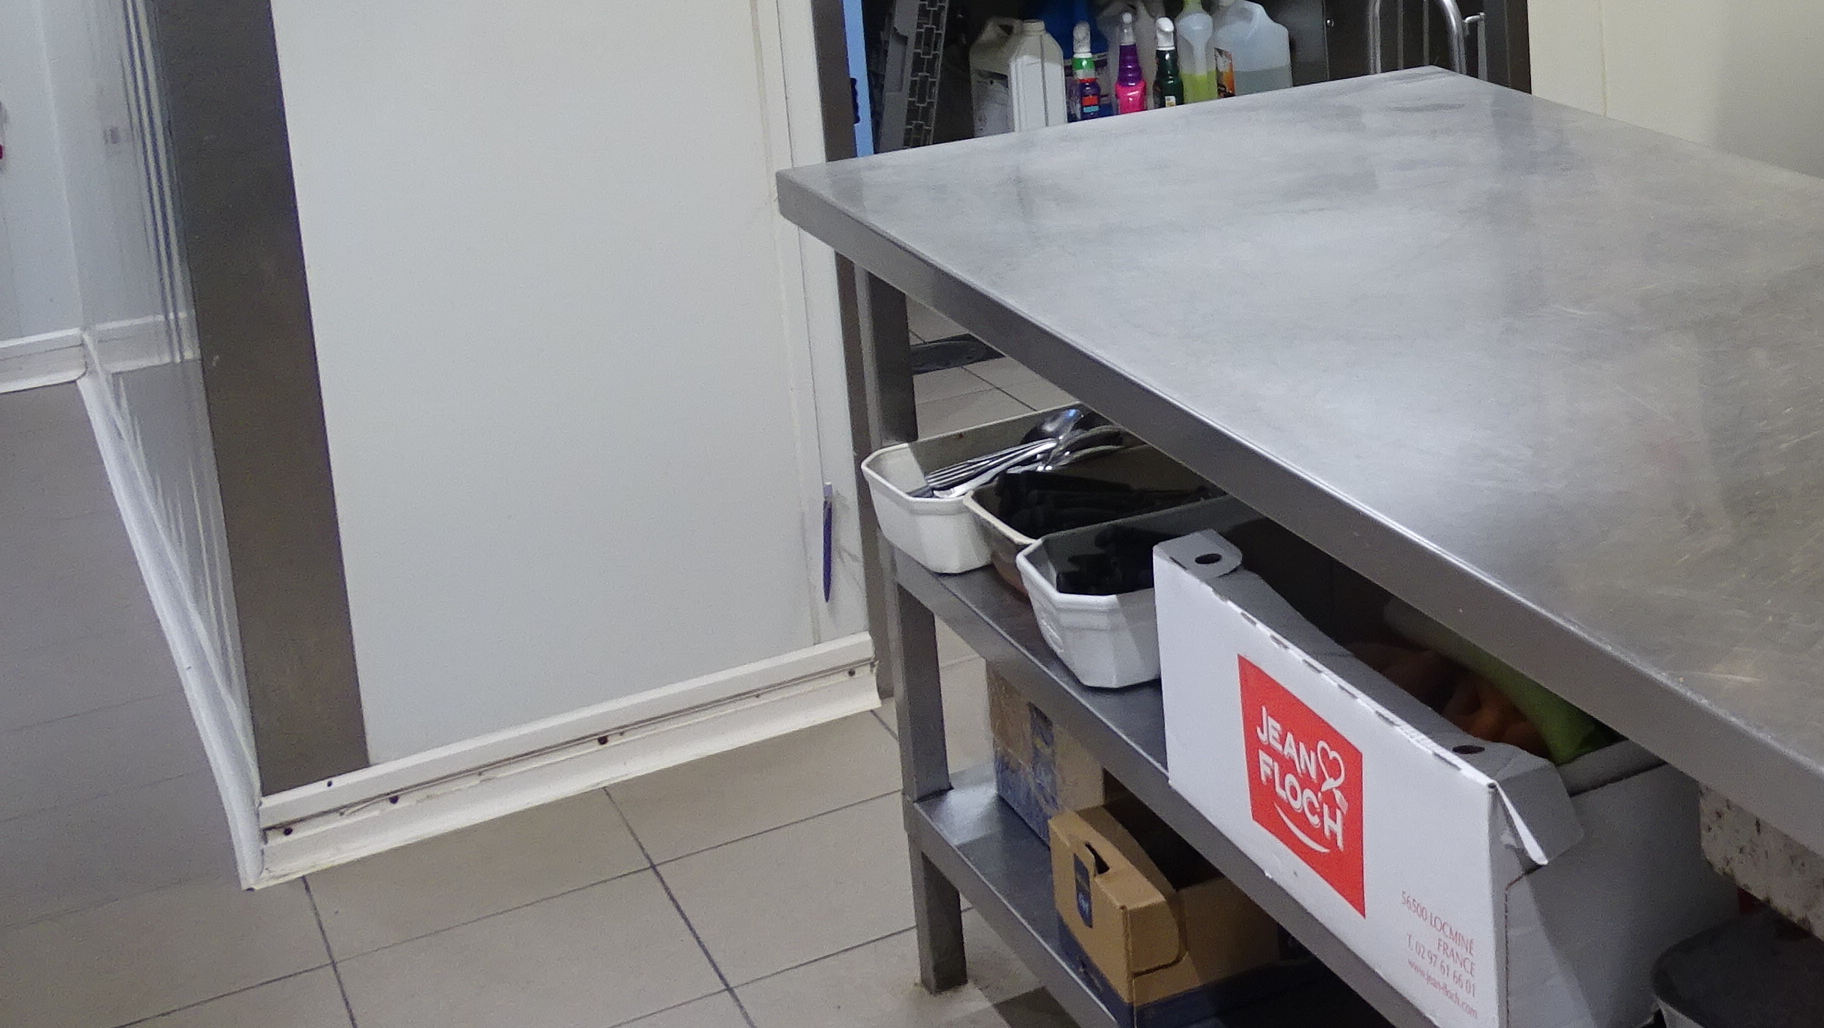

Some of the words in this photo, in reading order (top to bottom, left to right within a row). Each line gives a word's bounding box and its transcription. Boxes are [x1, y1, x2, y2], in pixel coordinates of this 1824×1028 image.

[1256, 705, 1318, 784] JEAN
[1258, 748, 1344, 852] FLOCH
[1401, 890, 1428, 923] 56500
[1415, 941, 1426, 960] 02
[1427, 951, 1438, 967] 97
[1440, 960, 1450, 978] 61
[1452, 970, 1464, 989] 66
[1465, 979, 1476, 998] 01
[1437, 938, 1477, 978] FRANCE
